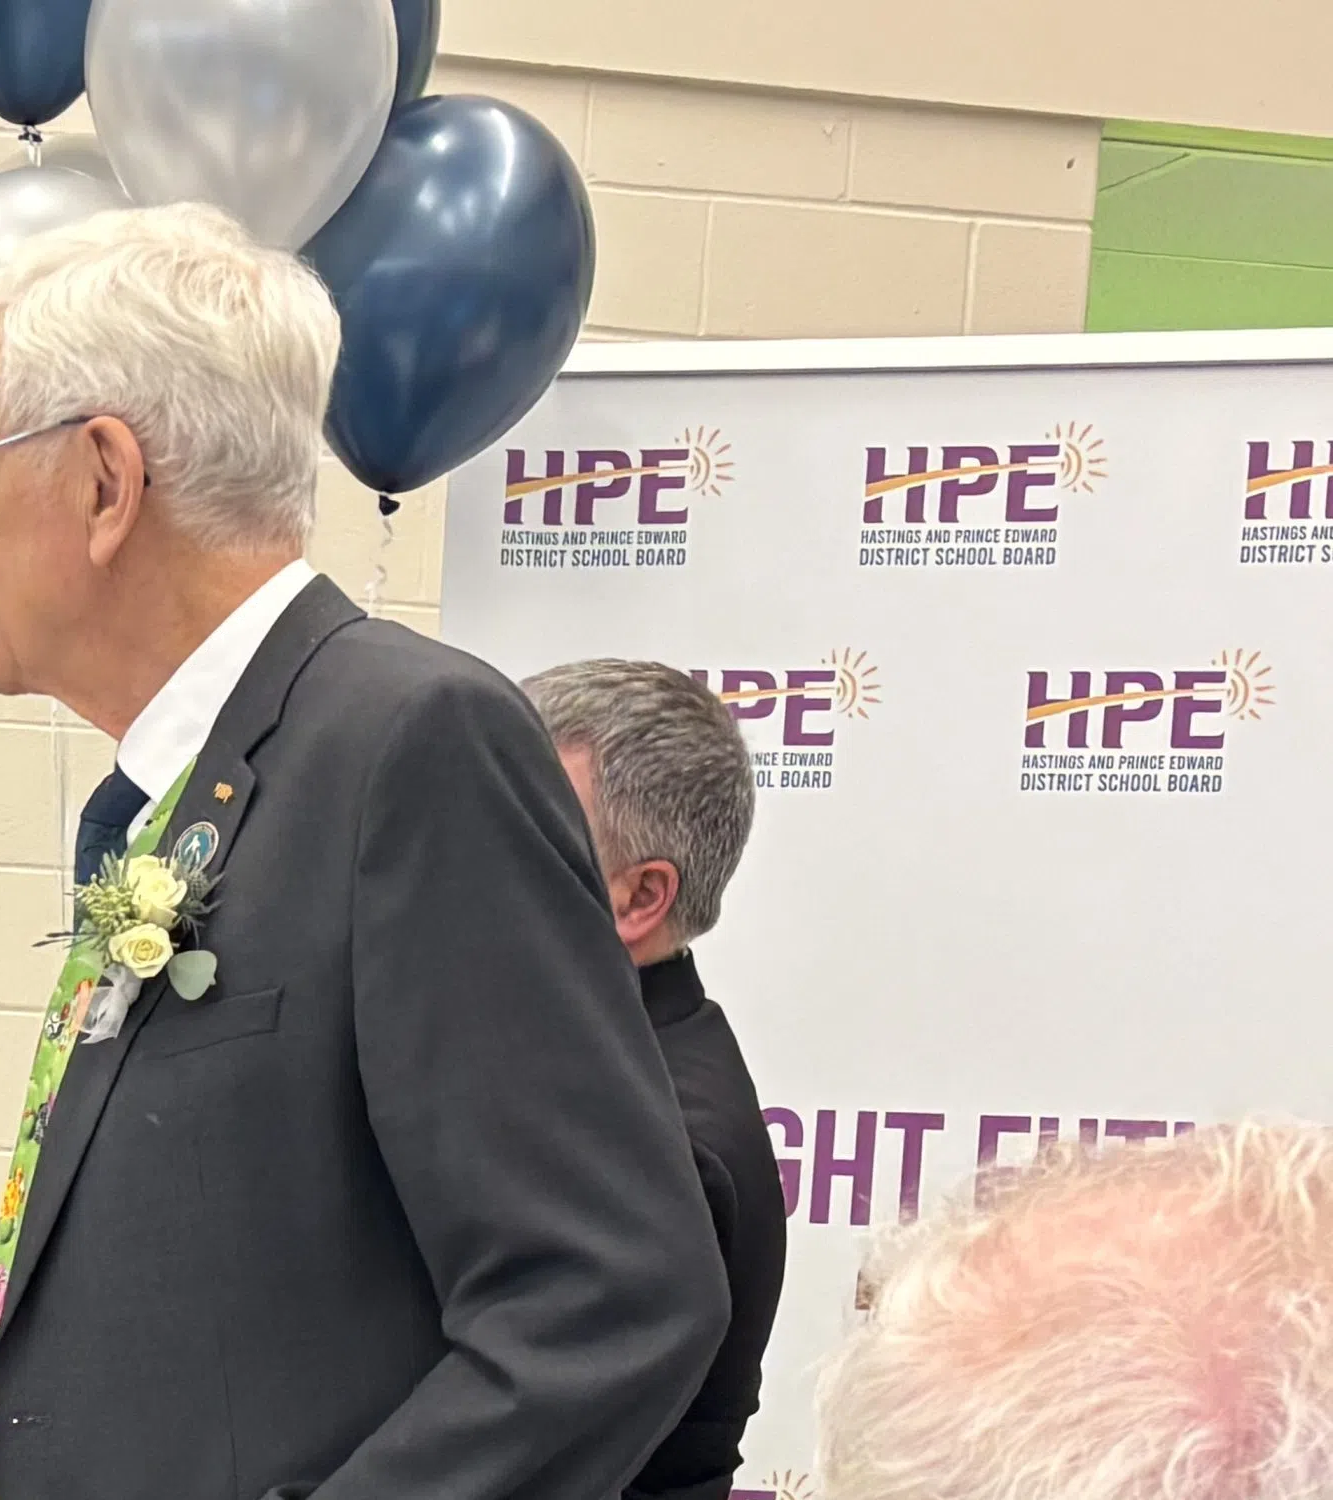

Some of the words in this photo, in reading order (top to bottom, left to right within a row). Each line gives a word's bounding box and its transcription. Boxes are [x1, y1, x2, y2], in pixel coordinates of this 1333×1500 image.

[504, 449, 690, 525] HPE
[863, 444, 1060, 523] HPE
[501, 530, 559, 545] HASTINGS
[562, 530, 587, 545] AND
[590, 530, 634, 545] PRINCE
[637, 530, 687, 544] EDWARD
[860, 529, 921, 544] HASTINGS
[925, 529, 950, 543] AND
[955, 529, 1000, 543] PRINCE
[1004, 528, 1057, 543] EDWARD
[1241, 526, 1307, 541] HASTINGS
[500, 548, 567, 567] DISTRICT
[571, 548, 630, 567] SCHOOL
[636, 548, 686, 566] BOARD
[859, 548, 930, 566] DISTRICT
[935, 547, 996, 566] SCHOOL
[1003, 547, 1056, 565] BOARD
[1240, 544, 1316, 563] DISTRICT
[690, 670, 836, 746] PE
[1024, 671, 1226, 749] HPE
[783, 752, 832, 766] EDWARD
[1022, 755, 1084, 769] HASTINGS
[1088, 755, 1114, 769] AND
[1118, 755, 1165, 769] PRINCE
[1169, 755, 1223, 770] EDWARD
[782, 770, 832, 788] BOARD
[1020, 773, 1093, 791] DISTRICT
[1098, 773, 1161, 792] SCHOOL
[1167, 774, 1222, 792] BOARD
[760, 1107, 945, 1226] GHT
